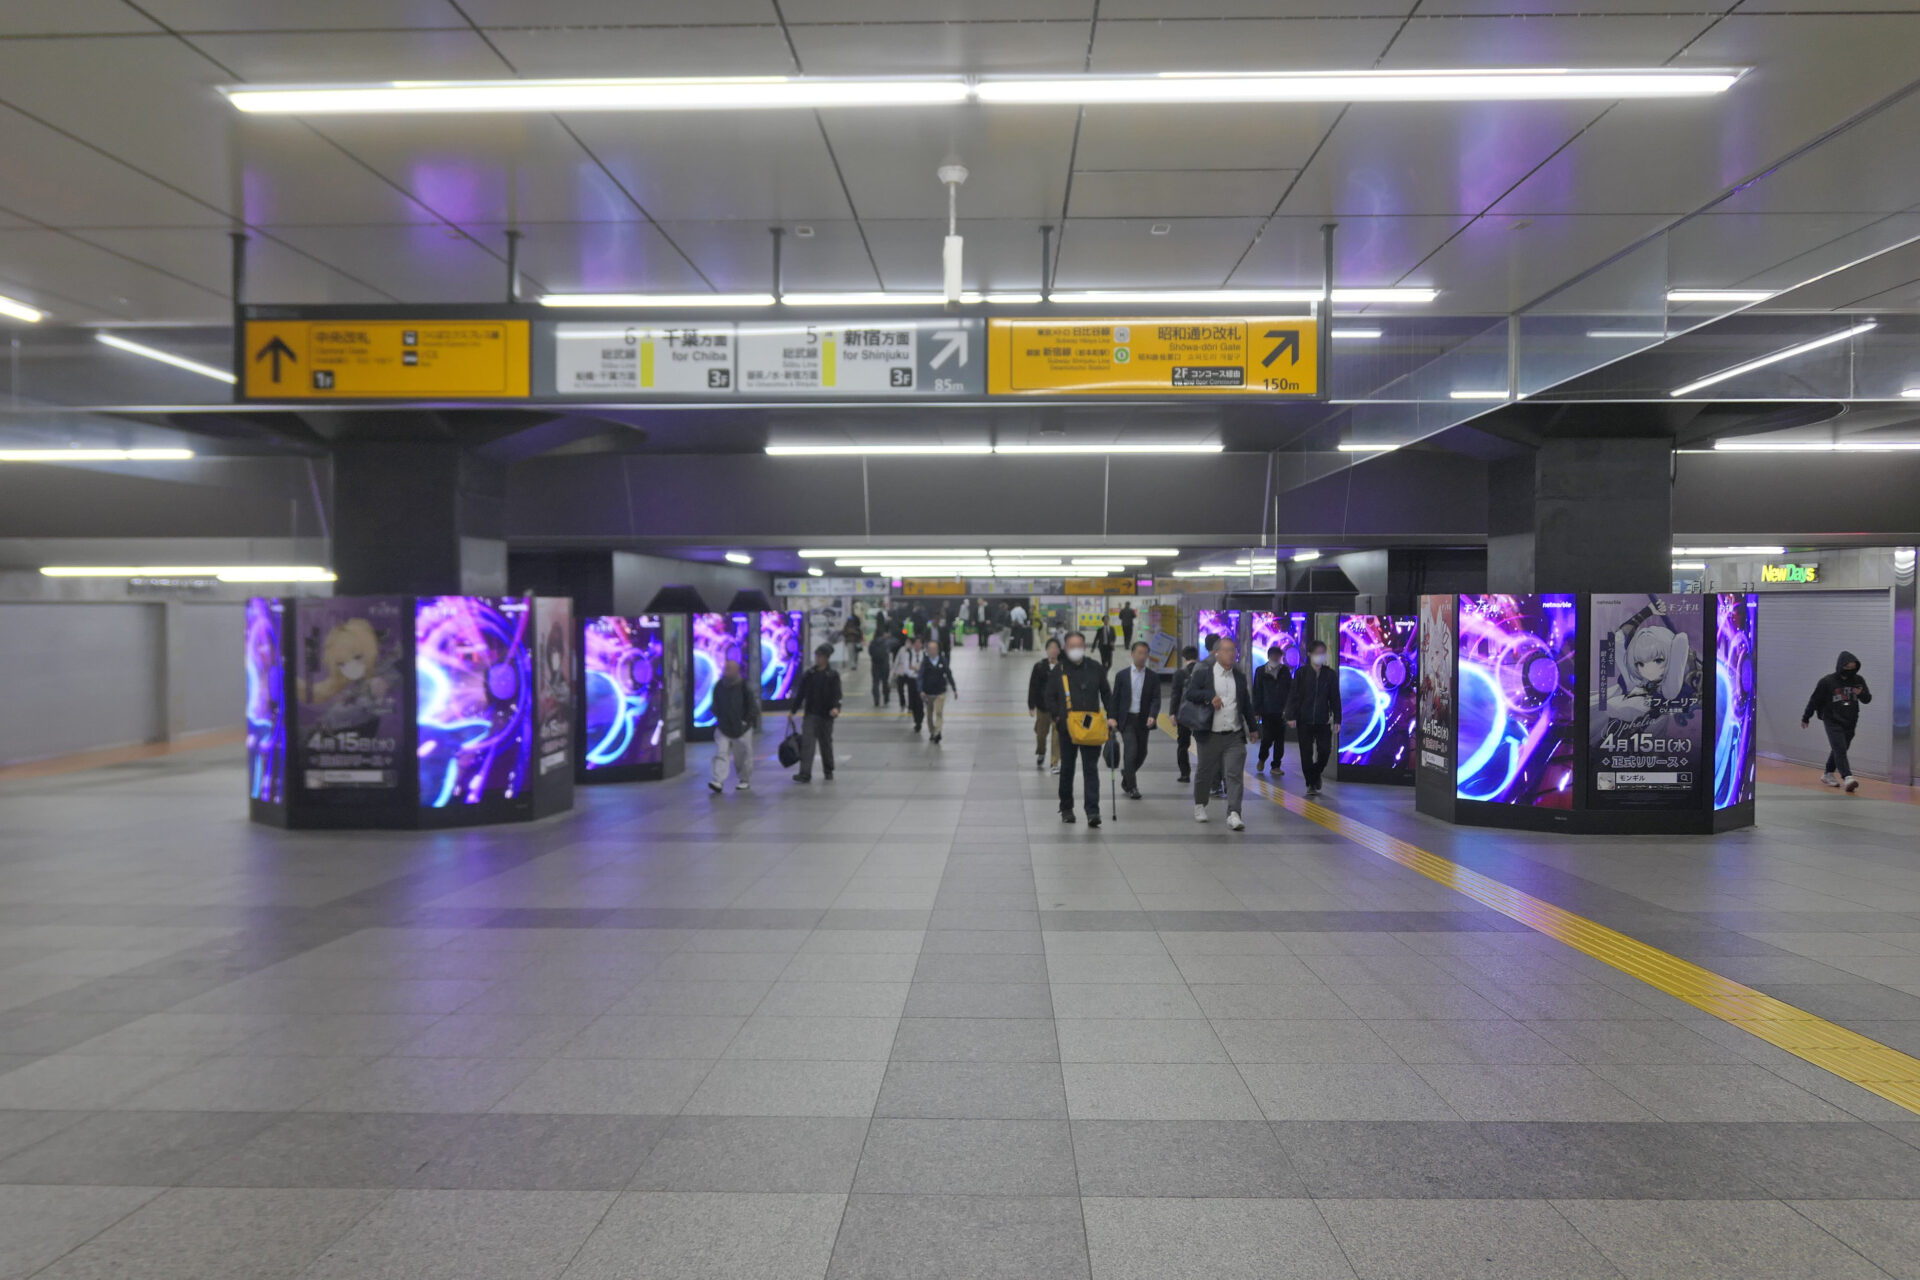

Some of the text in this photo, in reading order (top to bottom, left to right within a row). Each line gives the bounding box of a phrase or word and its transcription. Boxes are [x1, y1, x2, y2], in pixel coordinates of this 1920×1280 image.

[625, 327, 636, 345] 6
[662, 329, 728, 347] 千葉方面
[806, 326, 817, 344] 5
[843, 329, 909, 346] 新宿方面
[1158, 326, 1242, 341] 昭和通り改札
[1220, 342, 1240, 351] Gate
[672, 351, 728, 361] for Chiba
[843, 350, 909, 361] for Shinjuku
[710, 370, 728, 387] 3F
[892, 369, 910, 386] 3F
[1174, 367, 1188, 378] 2F
[1191, 370, 1241, 378] コンコース経由
[935, 378, 964, 391] 85m
[1263, 378, 1299, 390] 150m
[1761, 563, 1815, 583] NewDays
[1668, 603, 1699, 611] モンギル
[1644, 698, 1698, 707] オフィーリア
[1600, 733, 1692, 752] 4月15日(水)
[1611, 756, 1679, 768] 正式リリース
